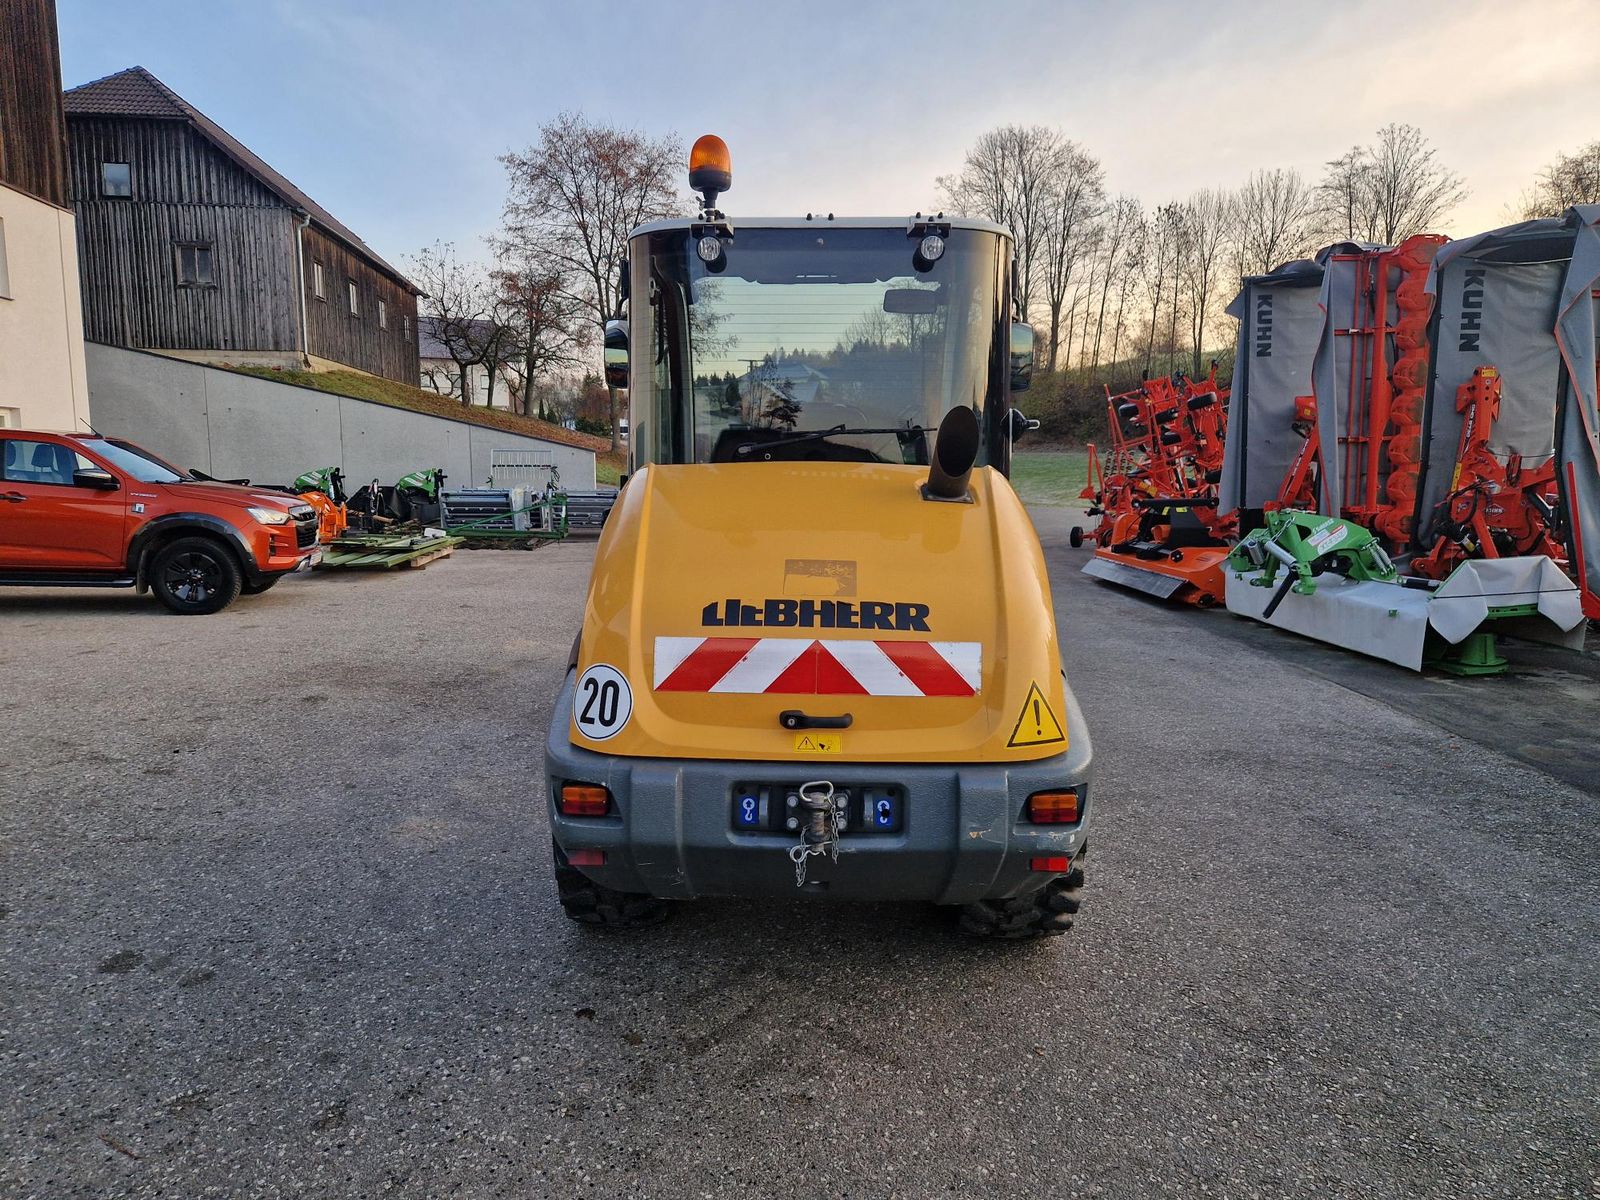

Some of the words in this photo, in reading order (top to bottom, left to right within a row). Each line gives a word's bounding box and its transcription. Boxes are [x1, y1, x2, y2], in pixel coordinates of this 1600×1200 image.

[1256, 294, 1273, 358] KUHN
[1458, 269, 1487, 352] KUHN
[701, 598, 932, 633] LIEBHERR
[580, 677, 620, 727] 20
